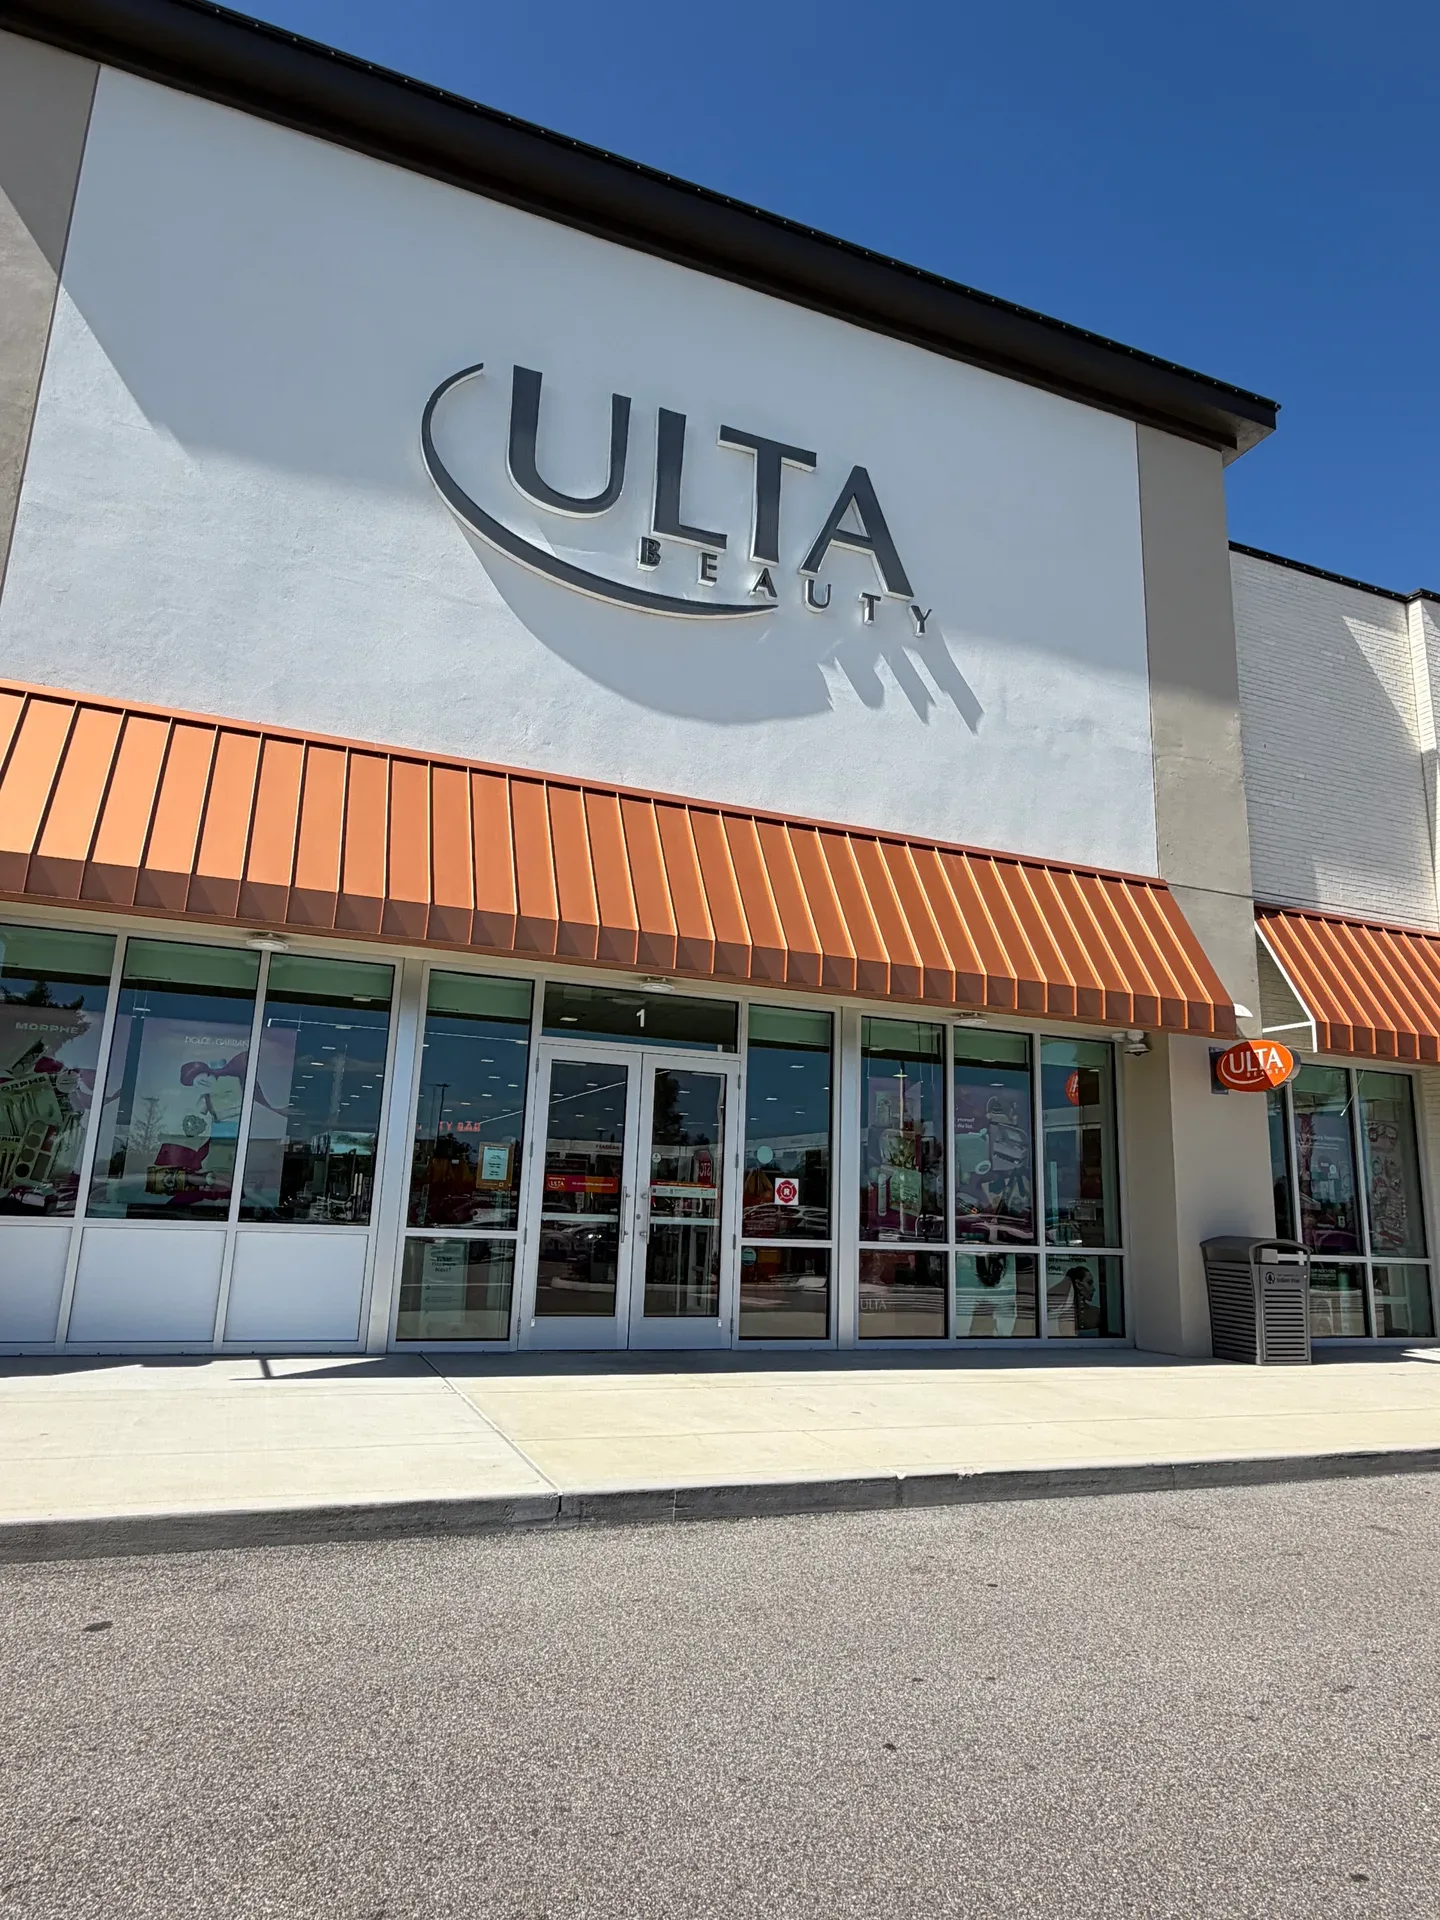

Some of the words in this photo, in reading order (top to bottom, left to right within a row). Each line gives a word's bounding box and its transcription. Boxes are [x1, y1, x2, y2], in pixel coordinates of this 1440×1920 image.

[506, 364, 915, 600] ULTA
[636, 536, 932, 637] BEAUTY
[636, 1009, 645, 1028] 1
[15, 1021, 80, 1034] MORPHE
[1229, 1046, 1284, 1074] ULTA
[1246, 1068, 1287, 1078] BEAUTY
[783, 1188, 790, 1196] R
[860, 1299, 887, 1310] ULTA
